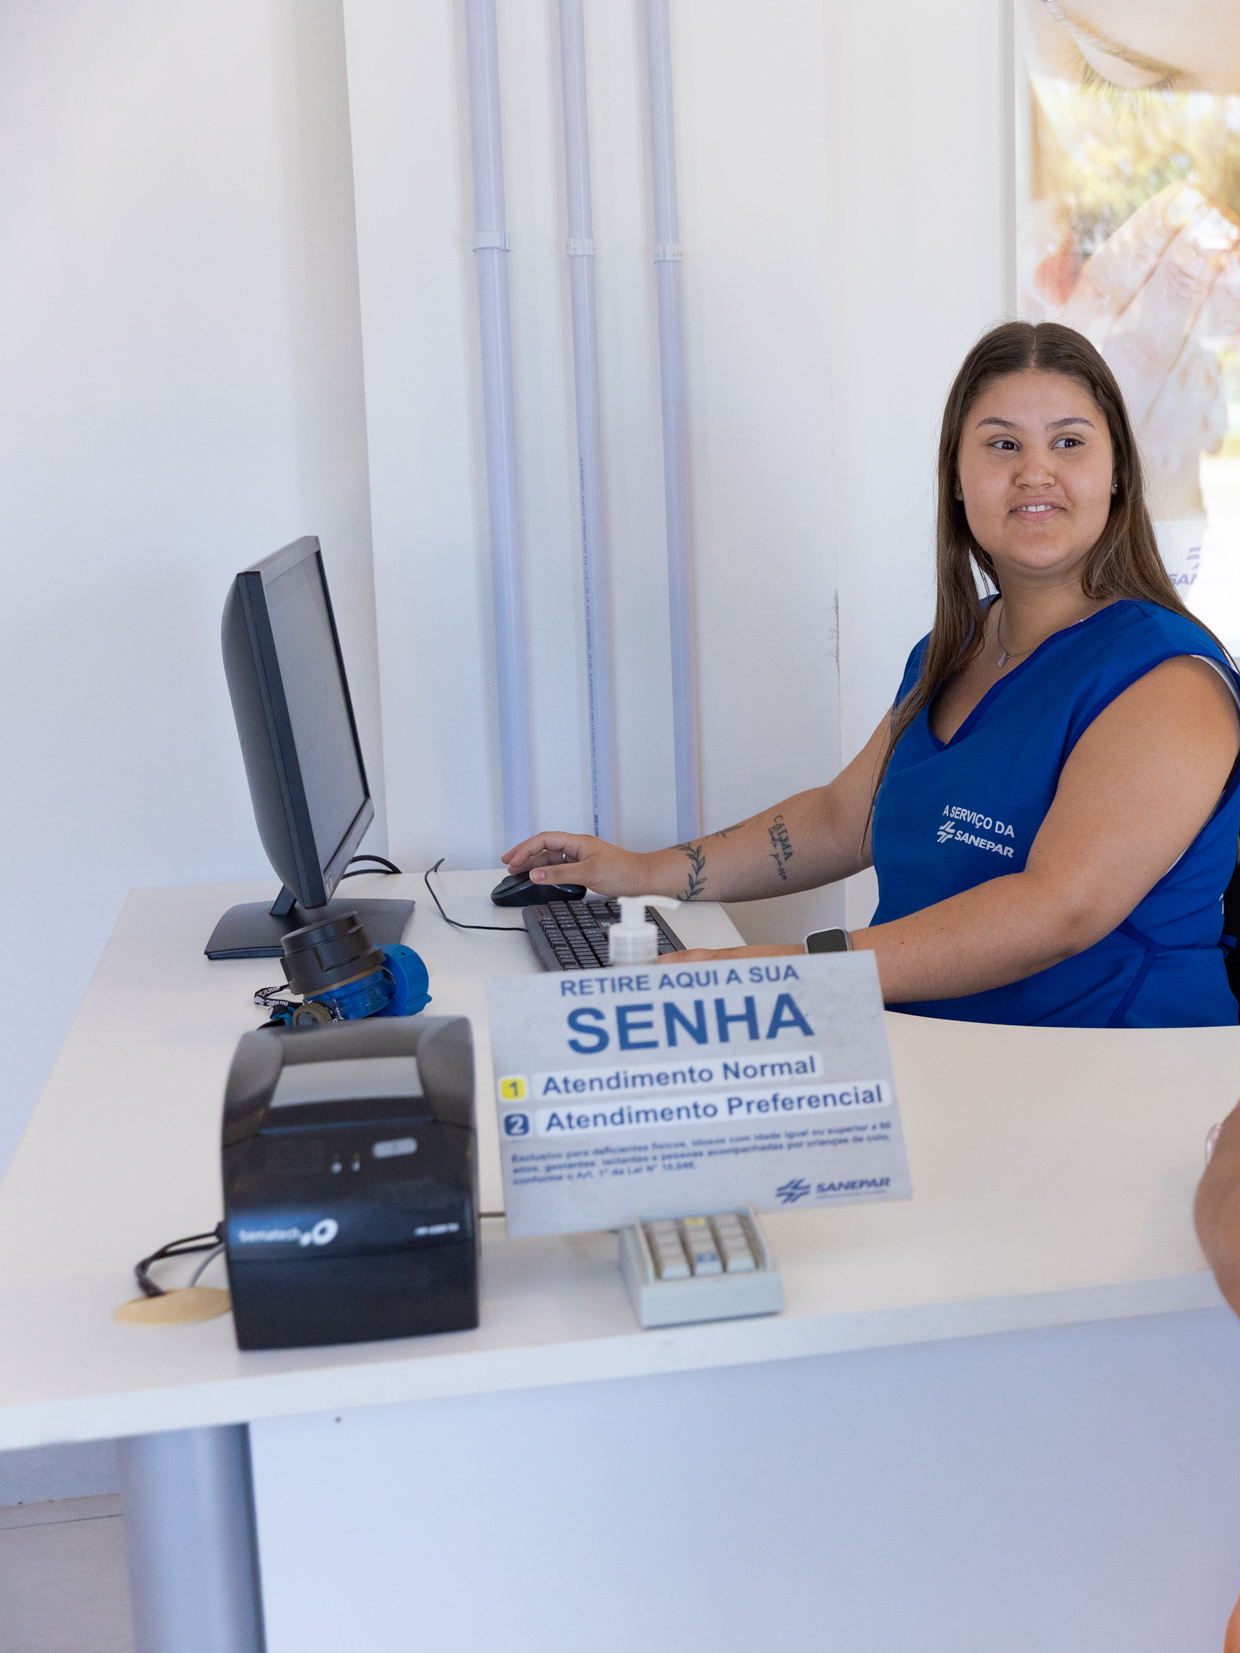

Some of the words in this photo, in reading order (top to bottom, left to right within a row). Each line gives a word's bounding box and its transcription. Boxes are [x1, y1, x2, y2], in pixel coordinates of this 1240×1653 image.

[774, 815, 793, 861] CALMA
[942, 804, 949, 816] A
[949, 805, 993, 829] SERVIÇO
[994, 820, 1015, 838] DA
[954, 830, 1015, 858] SANEPAR
[560, 974, 652, 997] RETIRE
[658, 970, 719, 990] AQUI
[725, 968, 742, 985] A
[748, 964, 800, 984] SUA
[566, 993, 815, 1055] SENHA
[541, 1066, 714, 1097] Atendimento
[722, 1055, 816, 1081] Normal
[508, 1115, 525, 1135] 2
[545, 1102, 718, 1133] Atendimento
[726, 1084, 882, 1116] Preferencial
[816, 1176, 891, 1194] SANEPAR
